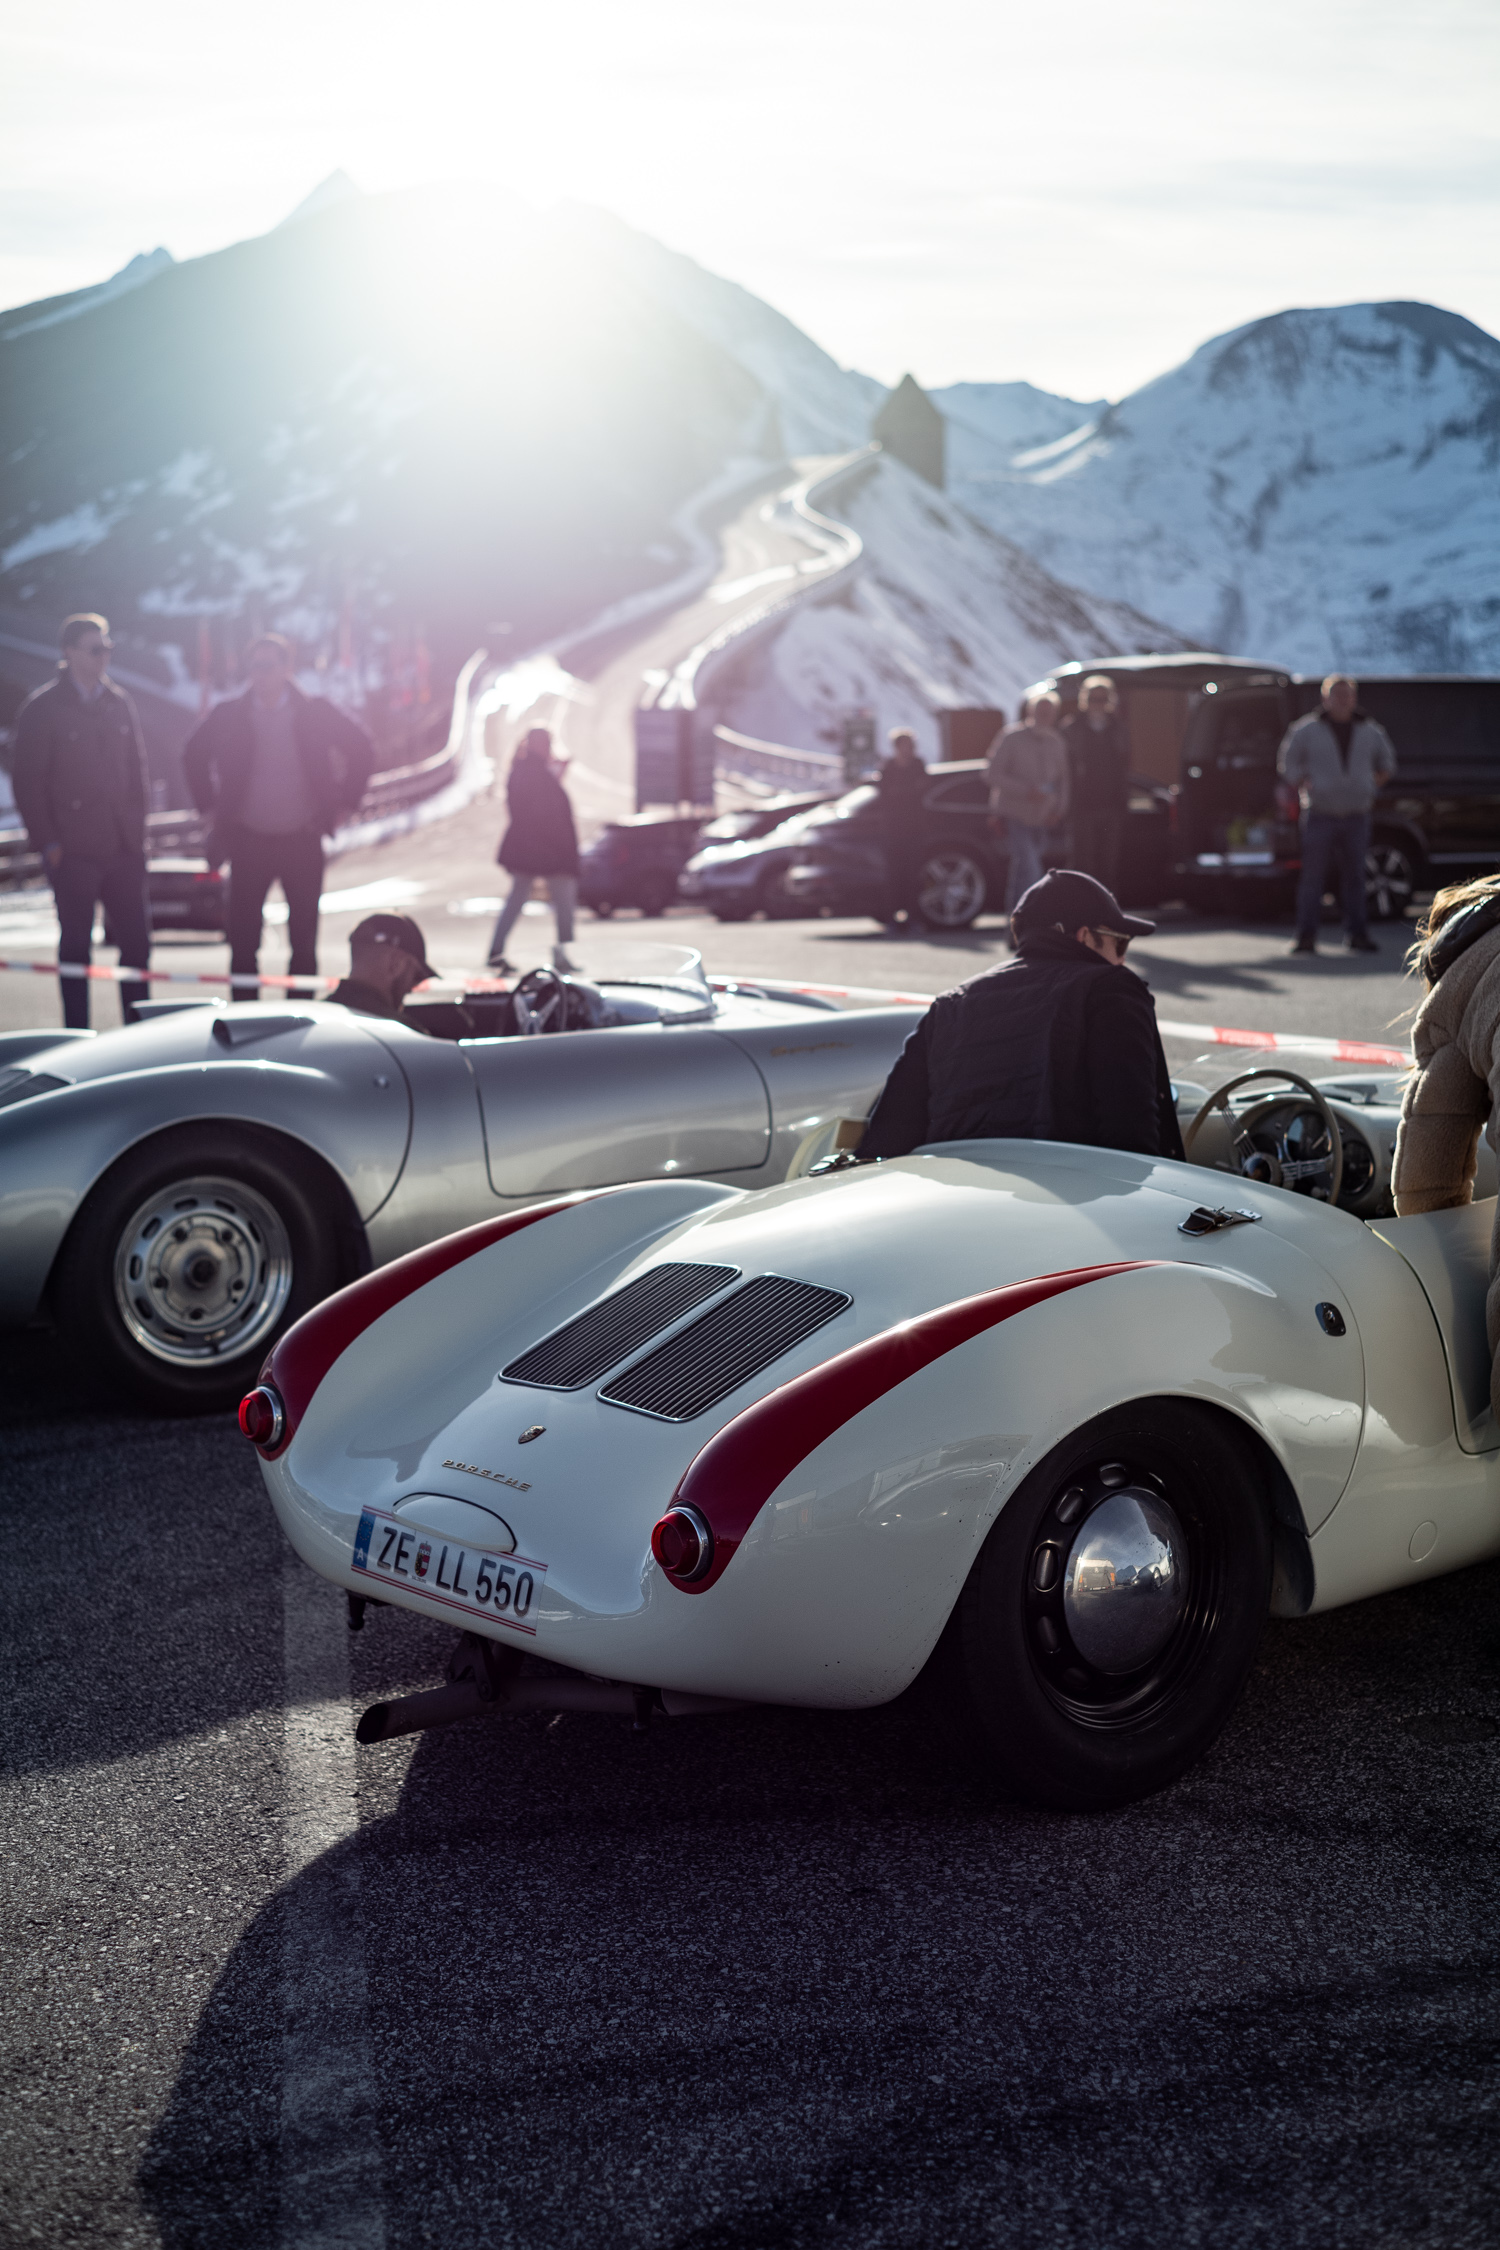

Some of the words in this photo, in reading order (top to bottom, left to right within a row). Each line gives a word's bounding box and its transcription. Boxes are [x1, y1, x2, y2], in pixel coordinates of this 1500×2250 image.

[442, 1459, 532, 1492] PORSCHE
[356, 1547, 364, 1561] A
[377, 1526, 416, 1576] ZE
[436, 1545, 468, 1597] LL
[475, 1558, 534, 1617] 550
